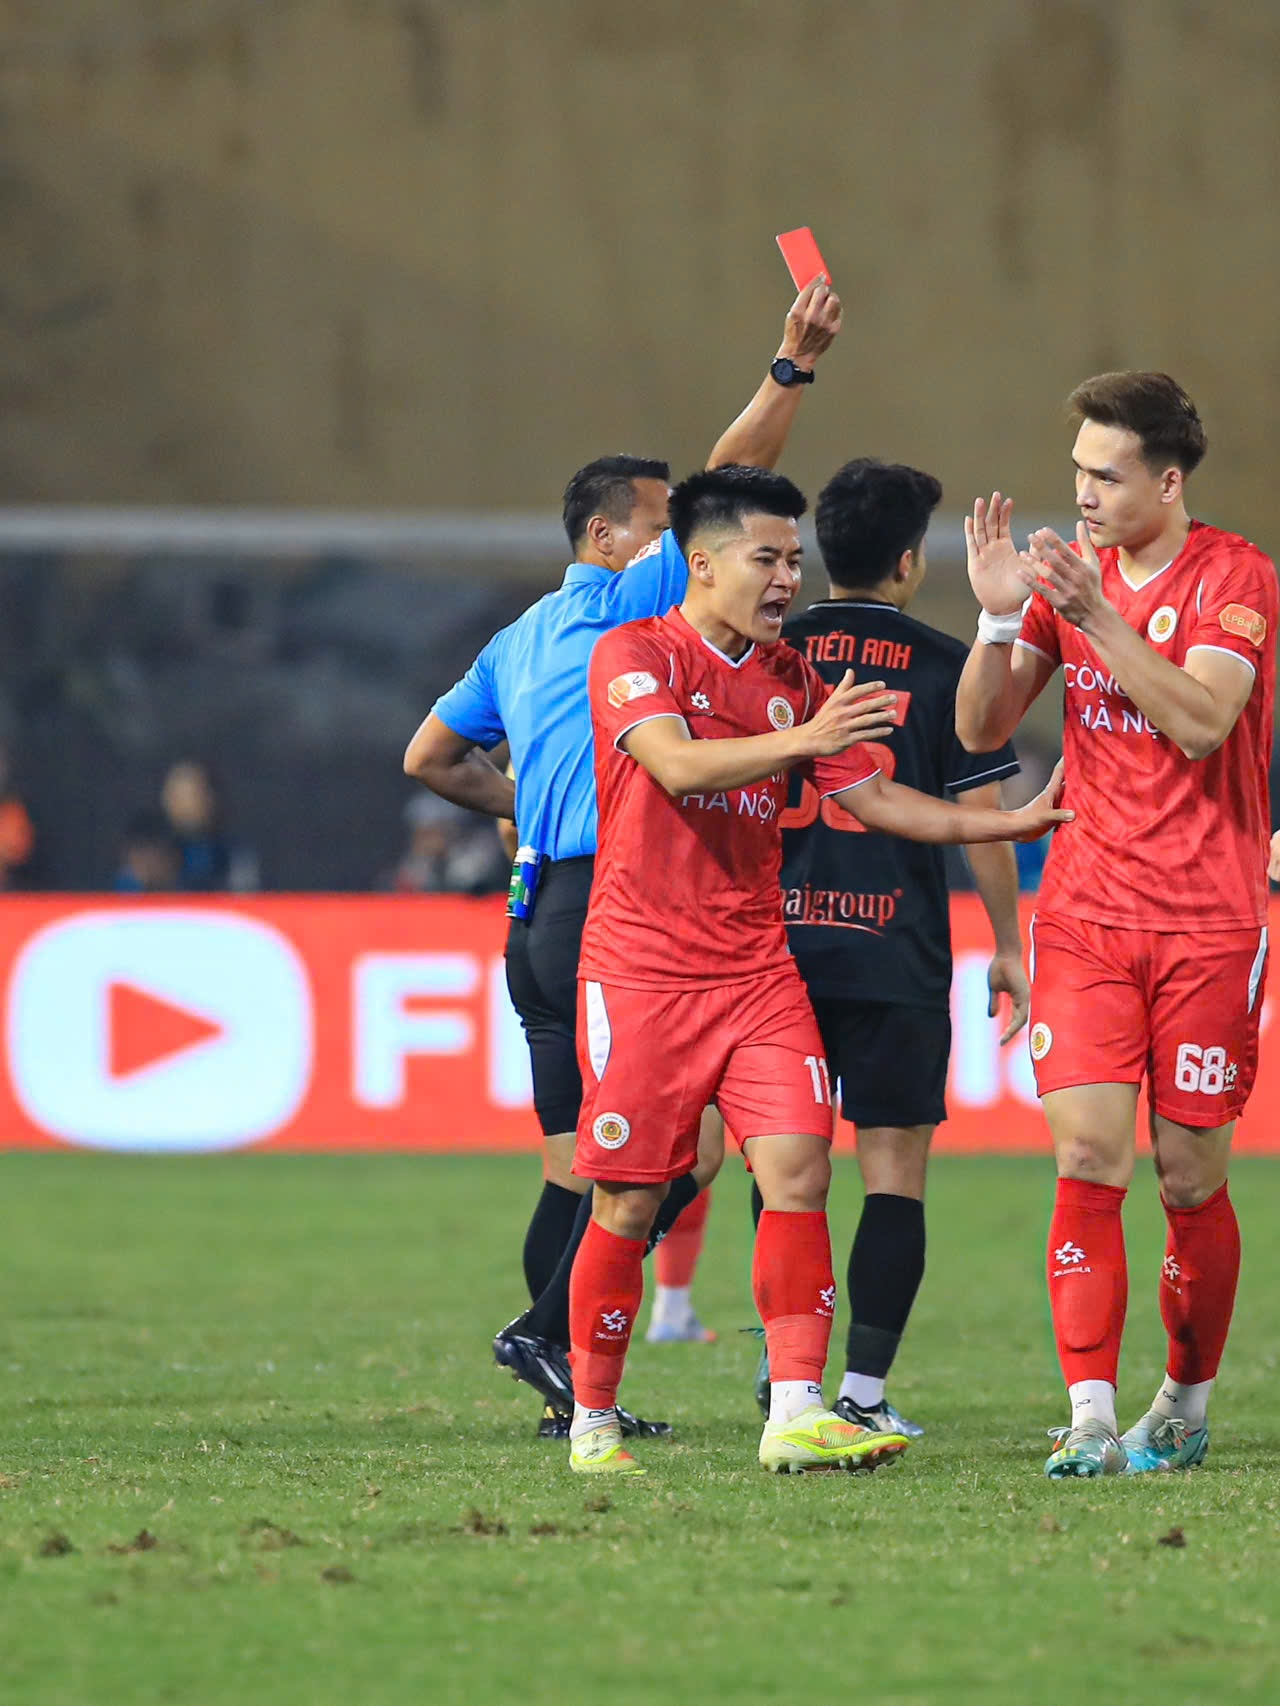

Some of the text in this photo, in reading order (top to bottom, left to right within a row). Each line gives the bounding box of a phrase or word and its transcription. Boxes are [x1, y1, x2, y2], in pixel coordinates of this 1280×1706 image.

[805, 630, 913, 671] TIẾN ANH
[803, 1055, 832, 1107] 11
[1174, 1042, 1227, 1096] 68
